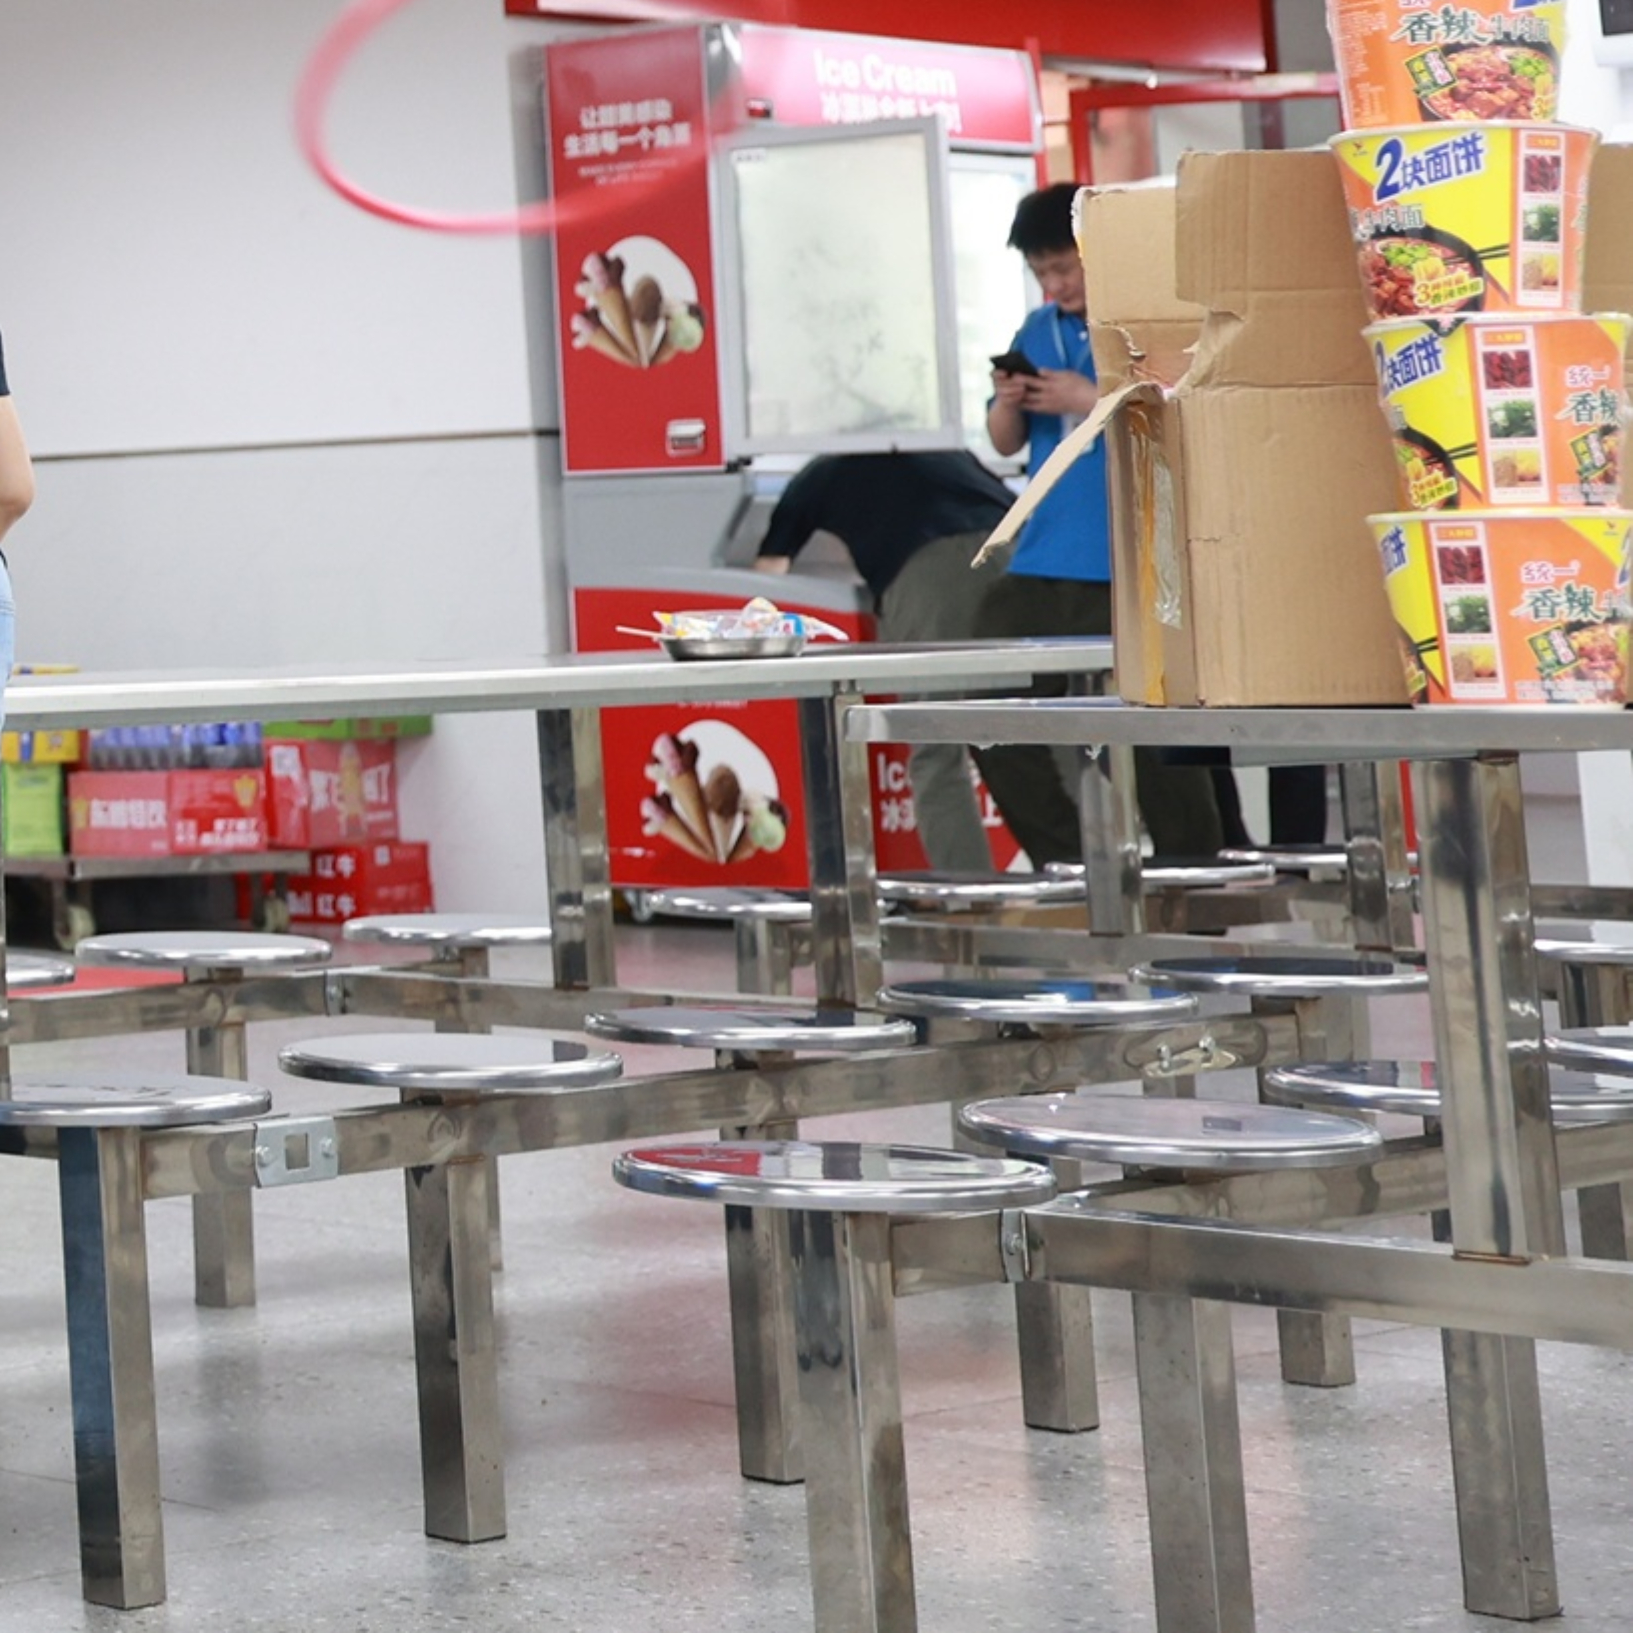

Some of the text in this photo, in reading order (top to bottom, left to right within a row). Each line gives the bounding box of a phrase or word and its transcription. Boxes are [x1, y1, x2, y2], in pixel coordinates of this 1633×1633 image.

[1391, 4, 1551, 44] 香辣牛肉面
[814, 48, 957, 98] Ice Cream
[1375, 131, 1484, 202] 2块面饼
[1522, 562, 1578, 583] 统一
